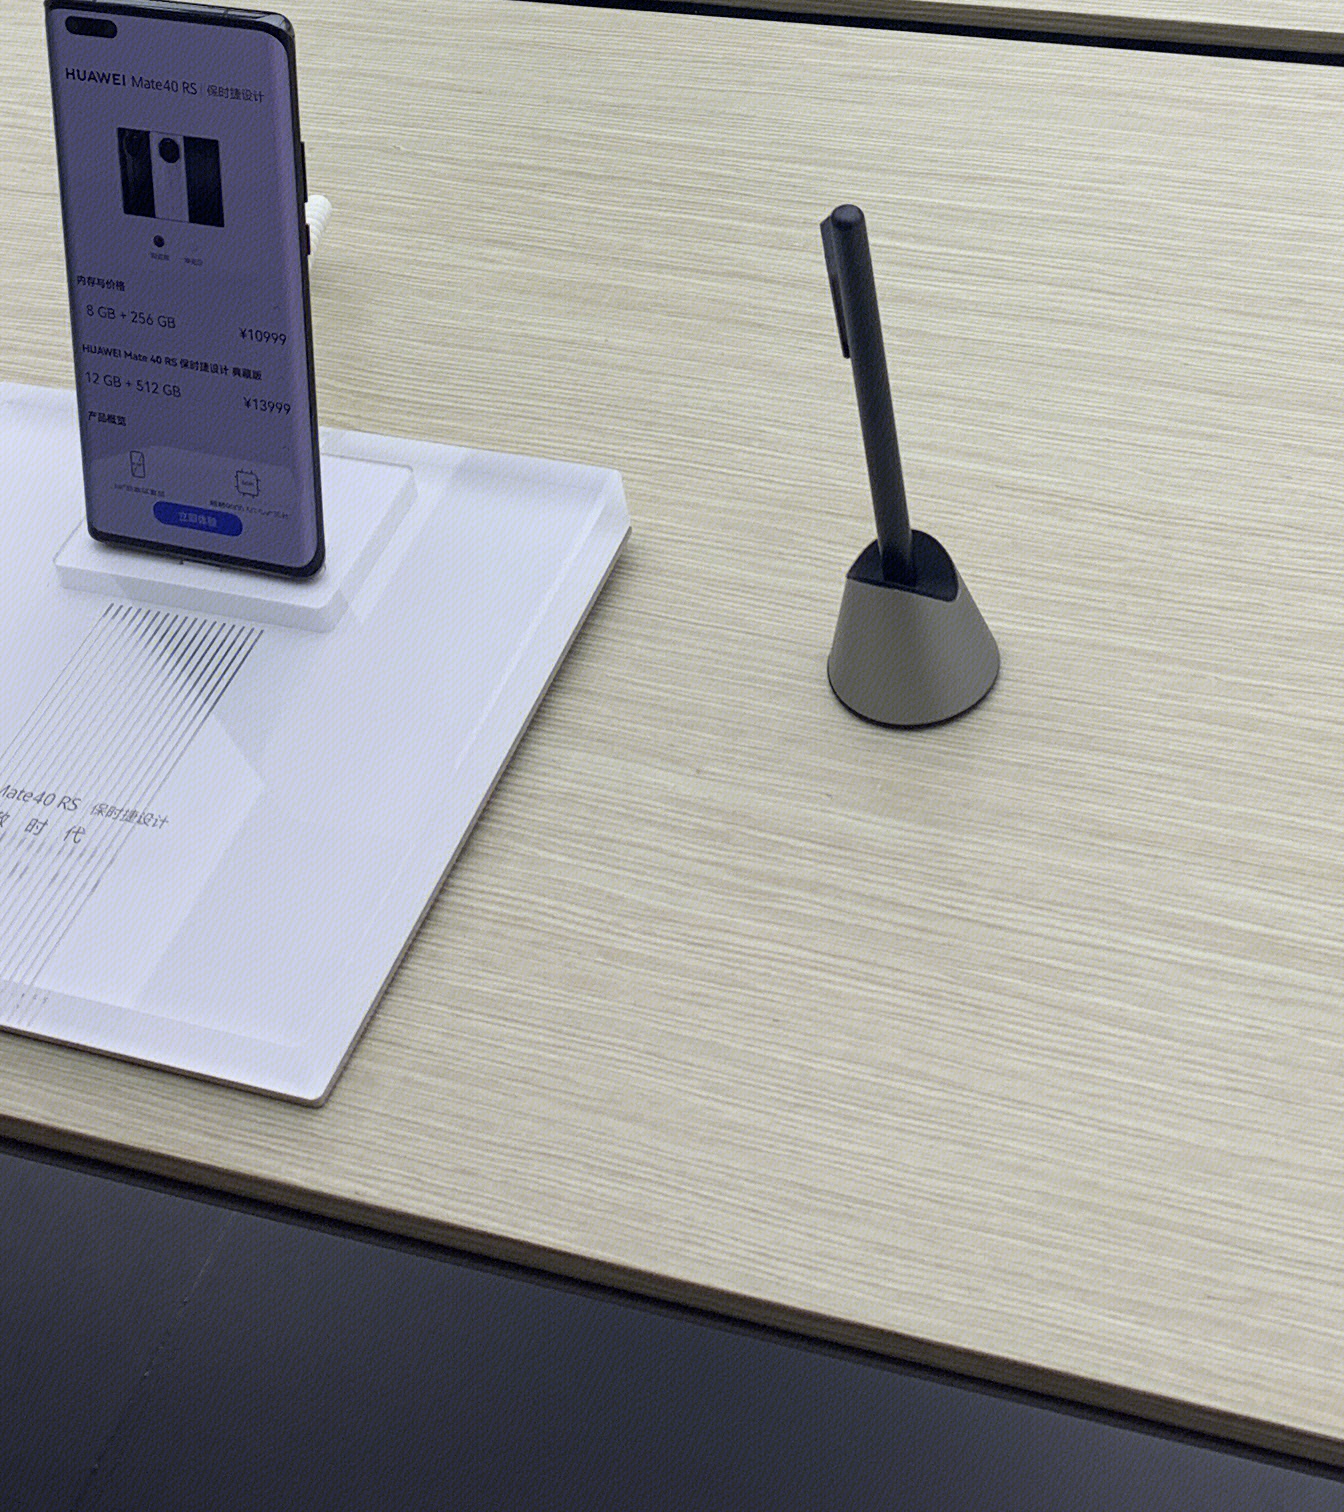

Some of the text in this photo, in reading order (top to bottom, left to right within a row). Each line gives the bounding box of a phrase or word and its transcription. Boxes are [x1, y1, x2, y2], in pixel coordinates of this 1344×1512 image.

[65, 67, 197, 95] HUAWEI Mate40 RS
[207, 84, 265, 104] 保时捷设计
[86, 304, 94, 317] 8
[97, 307, 116, 320] GB
[130, 311, 154, 326] 256
[157, 315, 176, 329] GB
[239, 327, 287, 346] ¥10999
[82, 344, 122, 359] HUAWEI
[124, 351, 148, 364] Mate
[150, 355, 162, 365] 40
[164, 357, 178, 368] RS
[85, 371, 100, 385] 12
[103, 374, 122, 389] GB
[136, 379, 159, 395] 512
[162, 383, 181, 398] GB
[244, 396, 291, 416] ¥13999
[57, 794, 83, 813] RS
[90, 802, 169, 831] 保时捷设计
